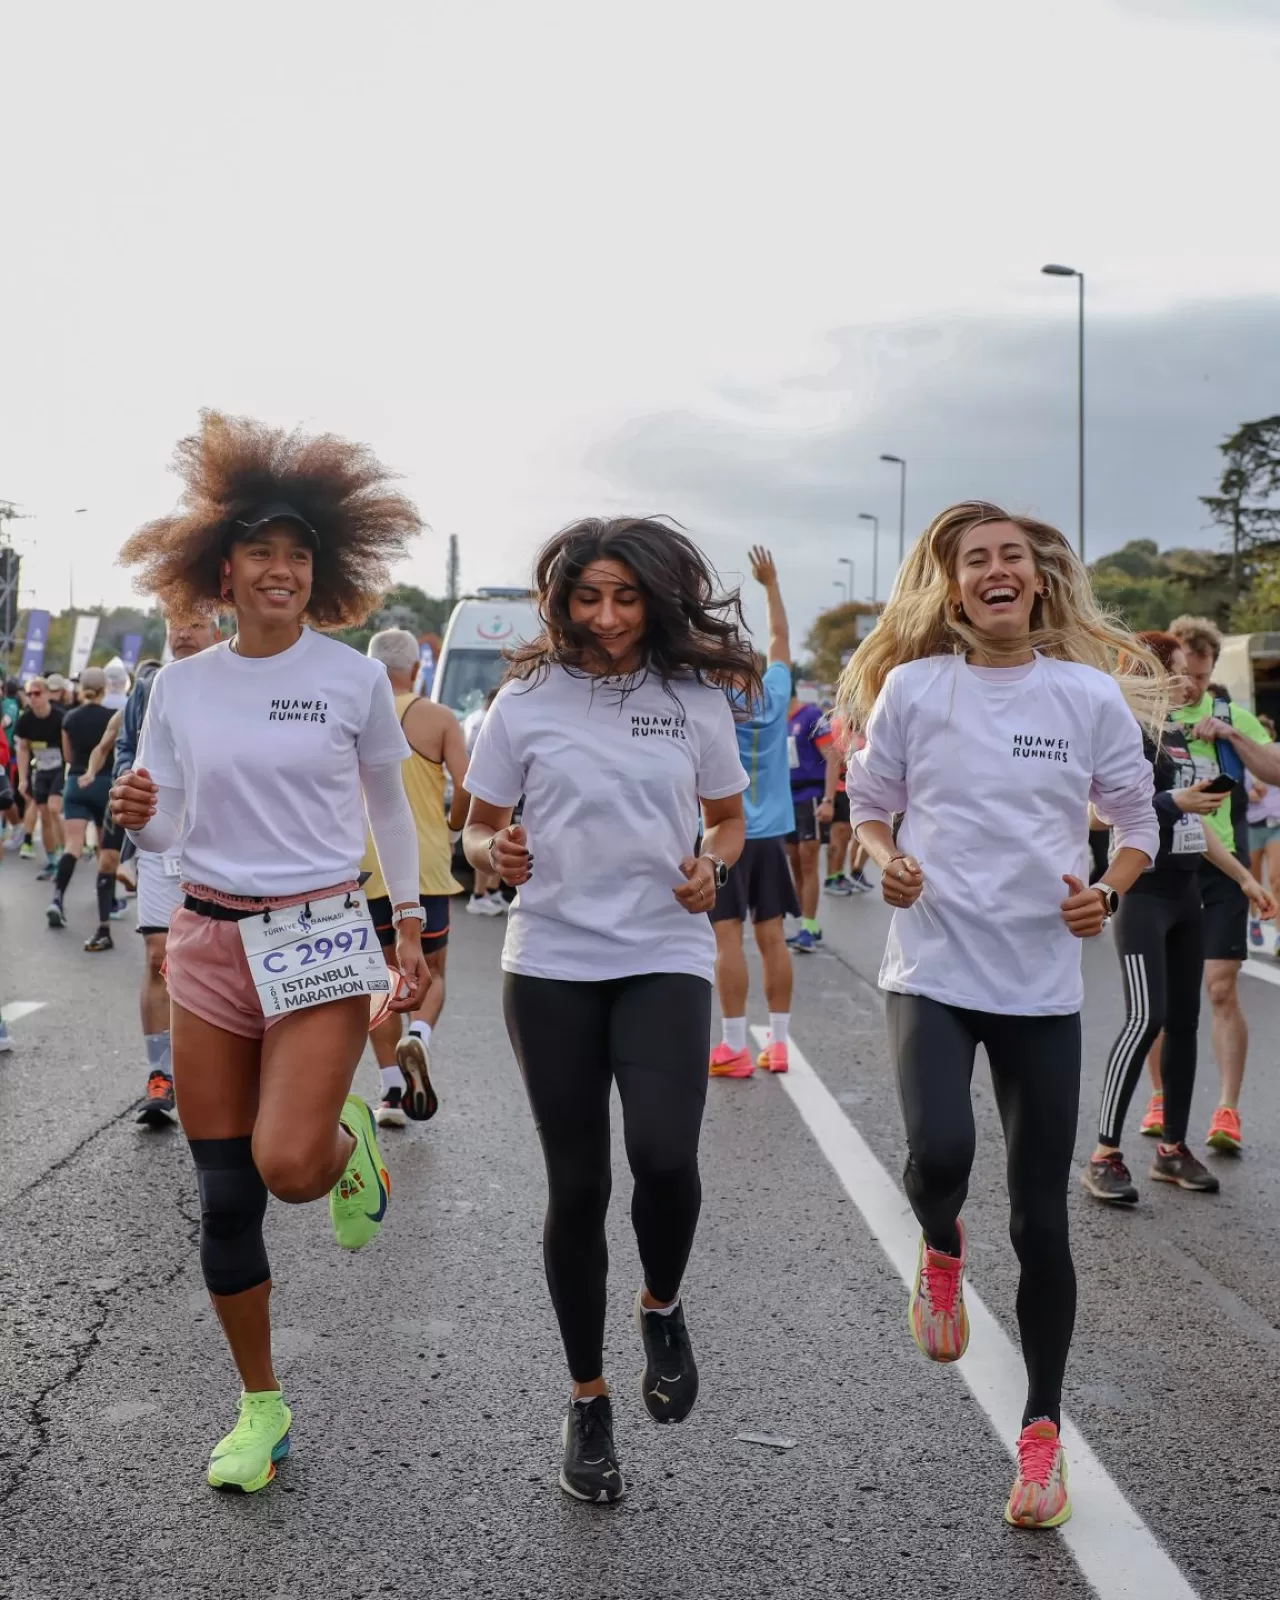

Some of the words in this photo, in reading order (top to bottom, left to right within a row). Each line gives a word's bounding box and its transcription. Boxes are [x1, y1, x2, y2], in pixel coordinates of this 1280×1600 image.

[271, 699, 328, 711] HUAWEI
[269, 711, 326, 723] RUNNERS
[631, 716, 685, 728] HUAWEI
[632, 727, 686, 740] RUNNERS
[1013, 734, 1069, 749] HUAWEI
[1012, 747, 1068, 763] RUNNERS
[310, 913, 345, 925] BANKASI
[263, 951, 288, 973] C
[295, 927, 369, 966] 2997
[281, 964, 359, 993] ISTANBUL
[269, 986, 281, 1011] 2024
[284, 980, 364, 1009] MARATHON
